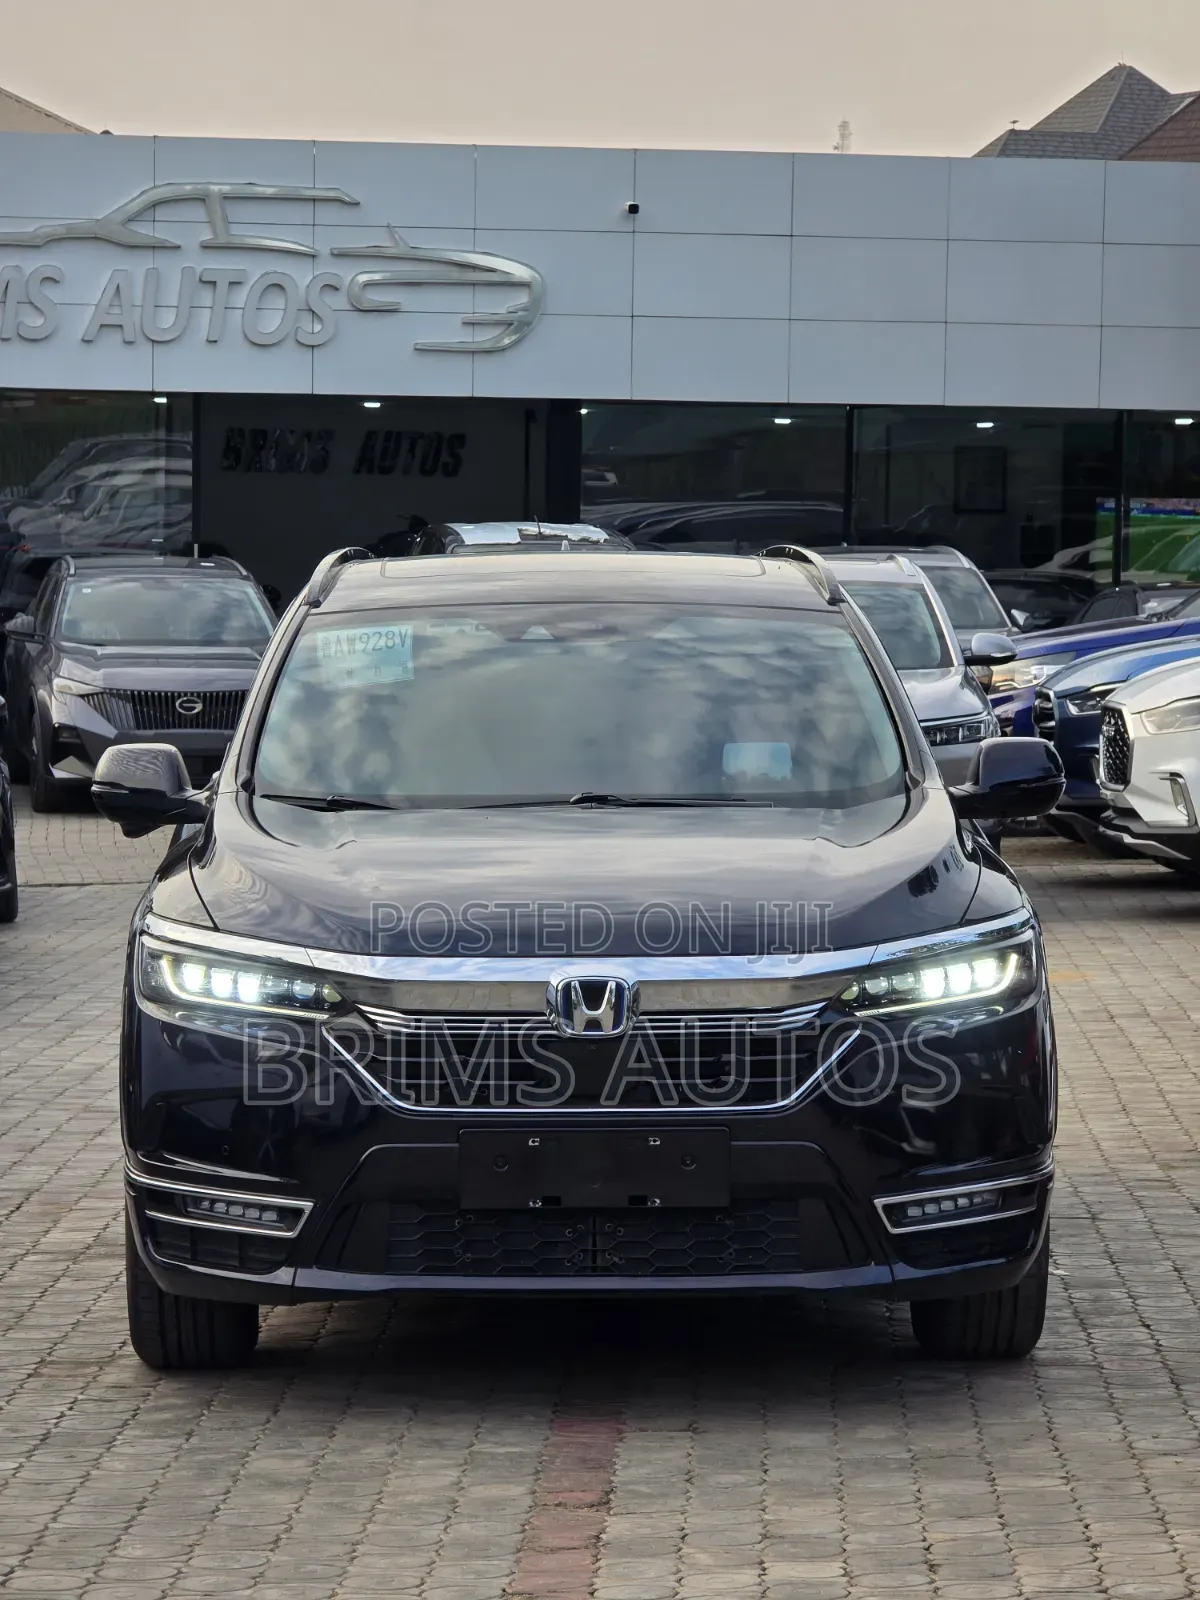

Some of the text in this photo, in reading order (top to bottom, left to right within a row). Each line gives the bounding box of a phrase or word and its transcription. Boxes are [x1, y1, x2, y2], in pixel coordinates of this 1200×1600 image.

[82, 266, 341, 346] AUTOS
[220, 426, 467, 478] BRIMS AUTOS
